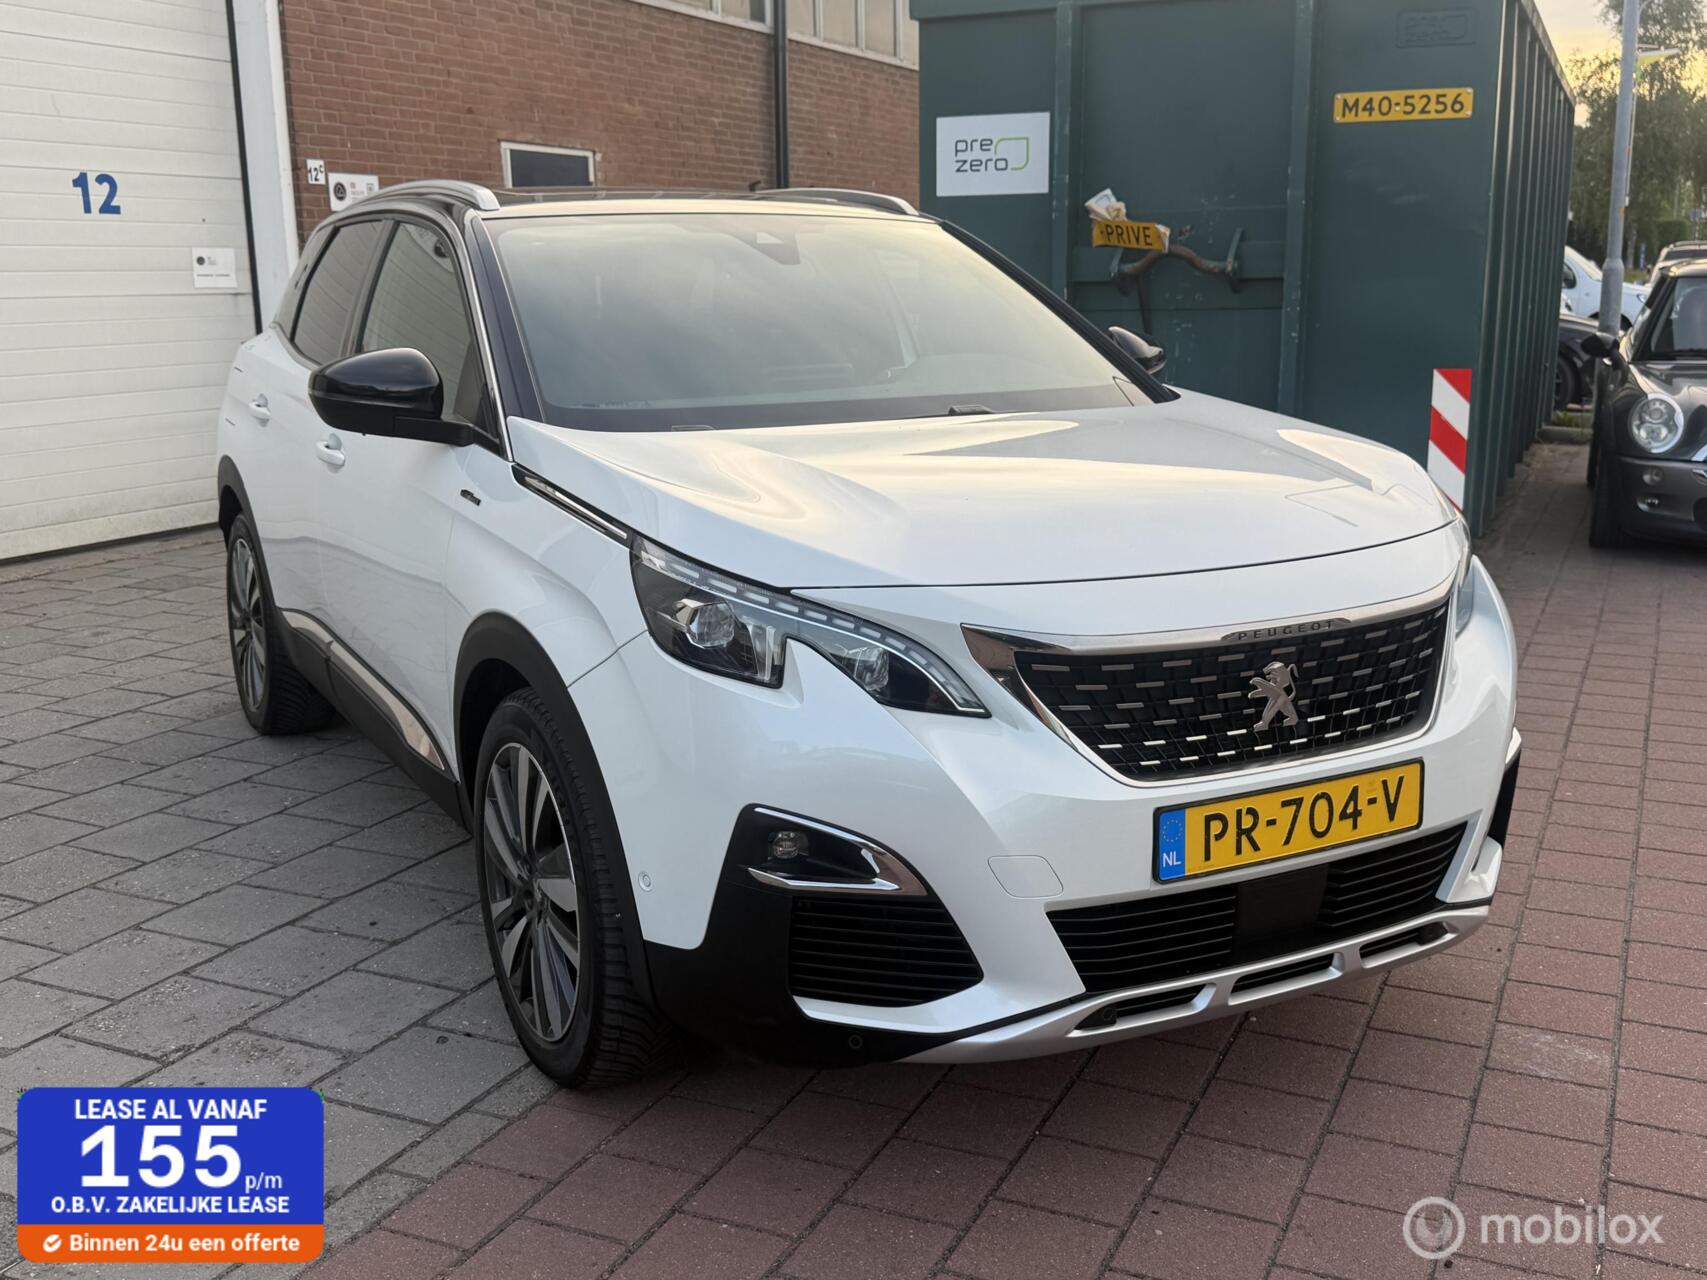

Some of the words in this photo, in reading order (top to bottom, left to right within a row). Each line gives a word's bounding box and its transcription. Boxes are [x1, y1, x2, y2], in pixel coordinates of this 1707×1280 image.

[1341, 92, 1465, 119] M40-5256
[954, 138, 994, 158] pre
[954, 158, 1009, 173] zero
[71, 171, 122, 215] 12
[1104, 223, 1153, 246] PRIVE
[1238, 621, 1333, 641] PEUGEOT
[1203, 775, 1405, 862] PR-704-V
[1162, 851, 1182, 868] NL
